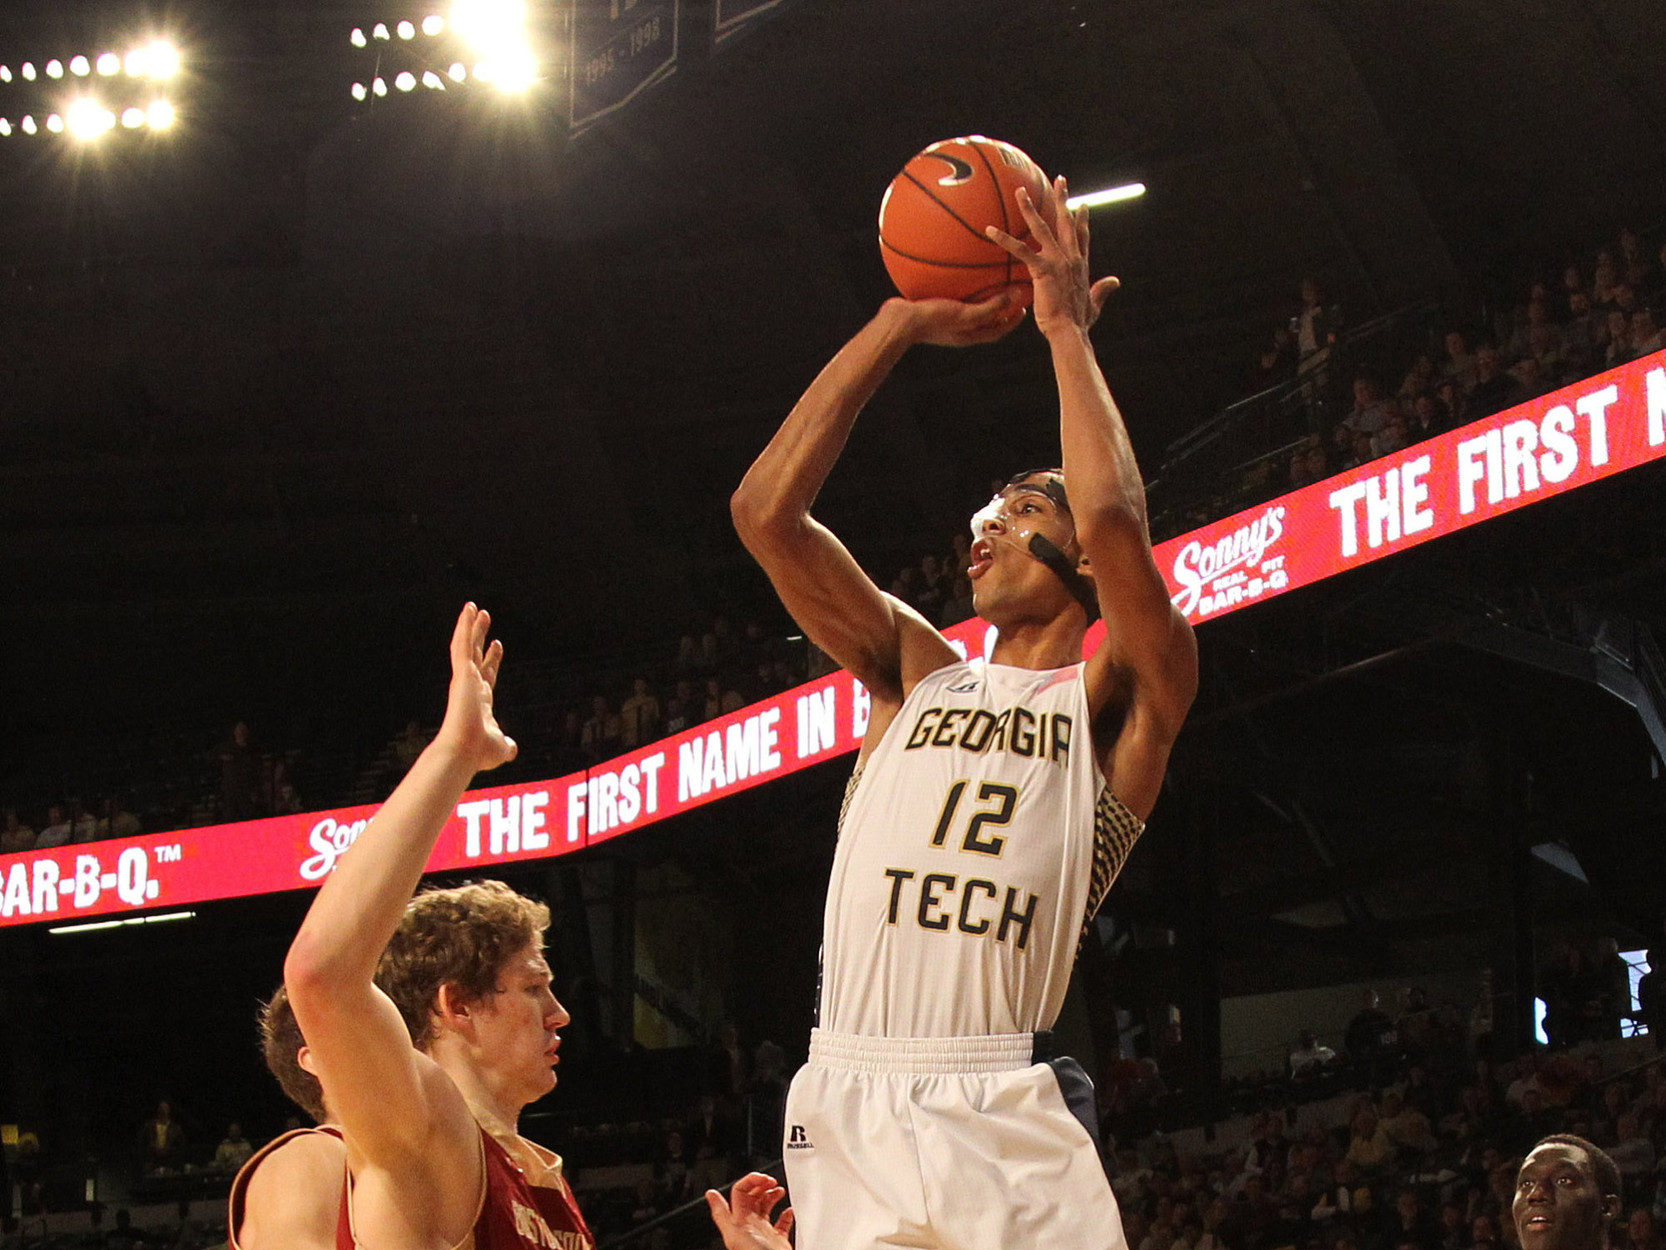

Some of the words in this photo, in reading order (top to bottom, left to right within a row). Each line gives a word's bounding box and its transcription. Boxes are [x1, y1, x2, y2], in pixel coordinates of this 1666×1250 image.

[1330, 455, 1434, 557] THE
[1458, 385, 1618, 514] FIRST
[1171, 507, 1285, 616] Sonny's
[457, 791, 550, 857] THE
[568, 752, 665, 842] FIRST
[678, 706, 781, 802] NAME
[797, 686, 836, 758] IN
[905, 706, 1074, 768] GEORGIA
[929, 779, 1020, 859] 12
[884, 867, 1038, 951] TECH
